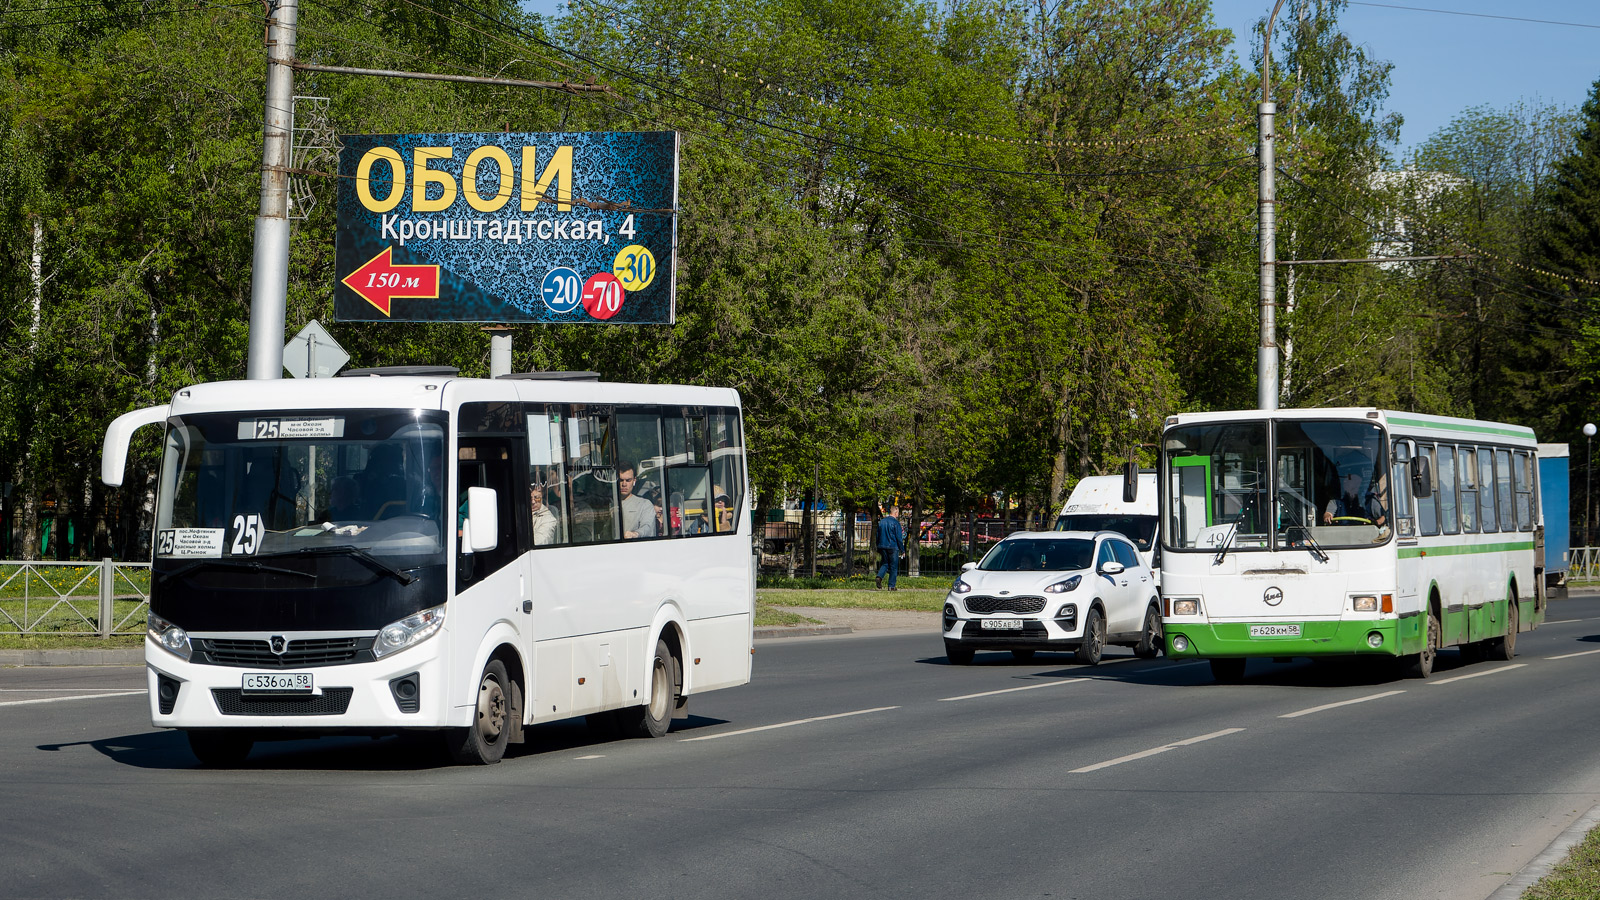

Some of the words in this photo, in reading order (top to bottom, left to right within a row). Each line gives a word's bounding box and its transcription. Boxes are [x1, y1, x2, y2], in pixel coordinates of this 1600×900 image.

[355, 145, 573, 213] ОБОИ
[381, 213, 611, 246] Кронштадтская,
[618, 214, 637, 240] 4
[364, 271, 400, 288] 150
[401, 277, 420, 288] м
[257, 421, 279, 439] 25
[158, 531, 174, 554] 25
[231, 514, 258, 555] 25
[1206, 532, 1225, 546] 49
[296, 675, 309, 685] 58
